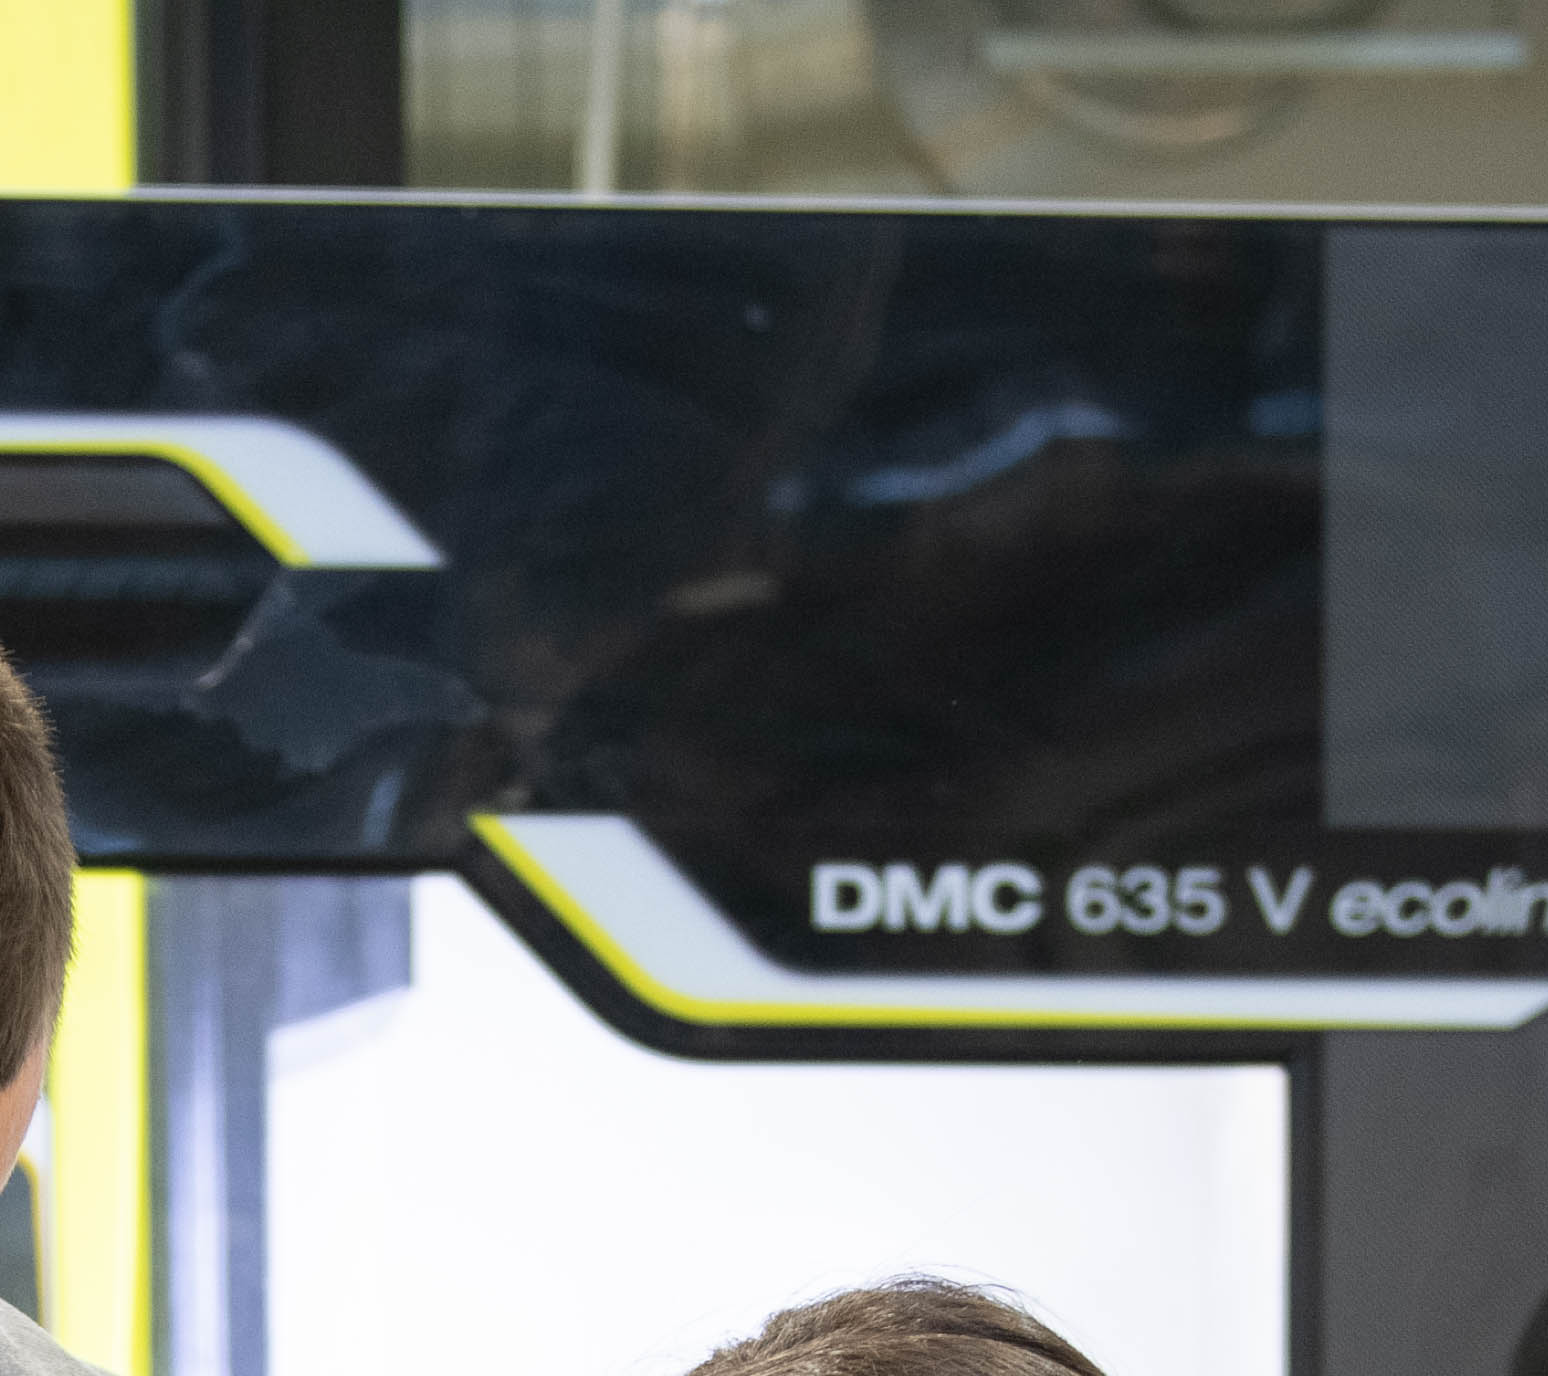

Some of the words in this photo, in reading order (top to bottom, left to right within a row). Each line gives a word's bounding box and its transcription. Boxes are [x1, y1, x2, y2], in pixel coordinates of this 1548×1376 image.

[810, 862, 1044, 935] DMC
[1065, 865, 1227, 936] 635
[1246, 866, 1314, 935] V
